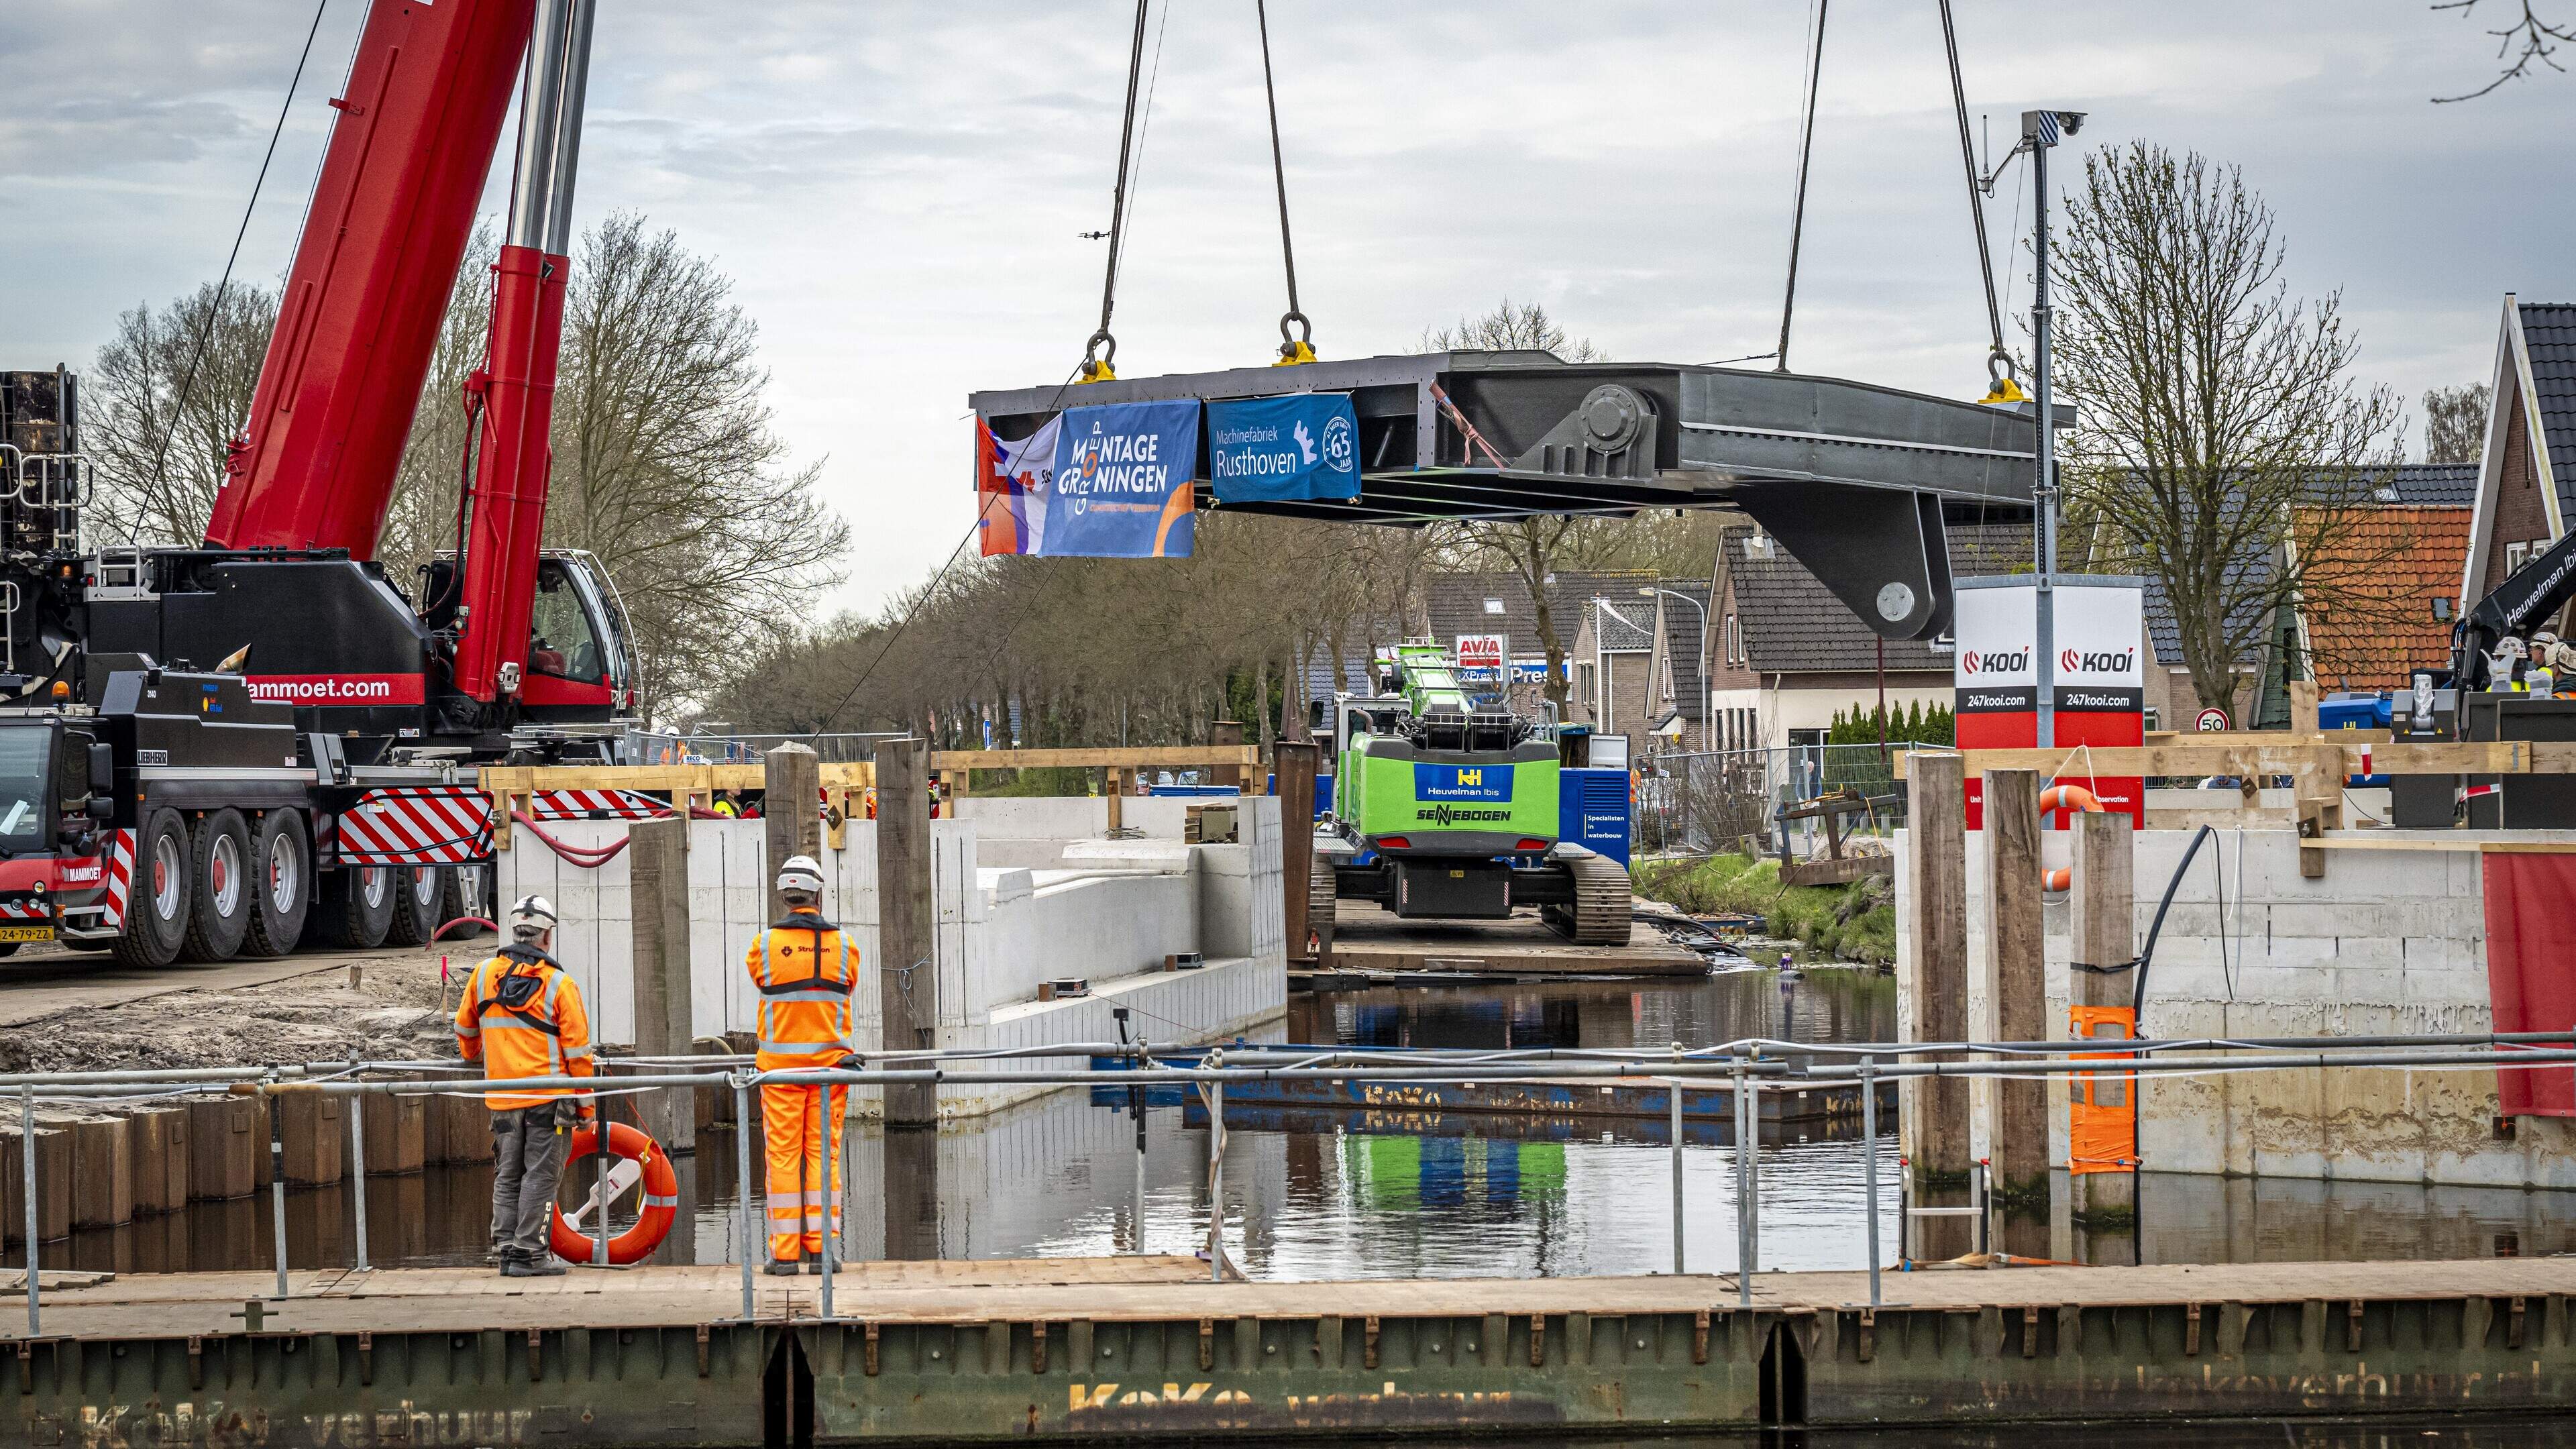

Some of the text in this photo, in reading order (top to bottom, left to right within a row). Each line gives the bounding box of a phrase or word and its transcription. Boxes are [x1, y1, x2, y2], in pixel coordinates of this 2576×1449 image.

[1216, 425, 1278, 445] Machinefabriek
[1331, 431, 1350, 458] 65
[1216, 446, 1295, 478] Rusthoven
[1340, 457, 1352, 468] JAAR
[2506, 548, 2576, 627] Heuvelman Ibi
[147, 690, 156, 698] 3140
[247, 679, 390, 698] ammoet.com
[1968, 694, 2025, 706] 247kooi.com
[2066, 694, 2130, 706] 247kooi.com
[2202, 718, 2224, 731] 50
[138, 751, 166, 764] LIEBHERR
[1428, 788, 1500, 796] Heuvelman Ibis
[2097, 796, 2129, 804] bservation
[69, 867, 101, 881] MAMMOET
[2, 930, 49, 940] 24-79-ZZ
[798, 945, 830, 953] Struon
